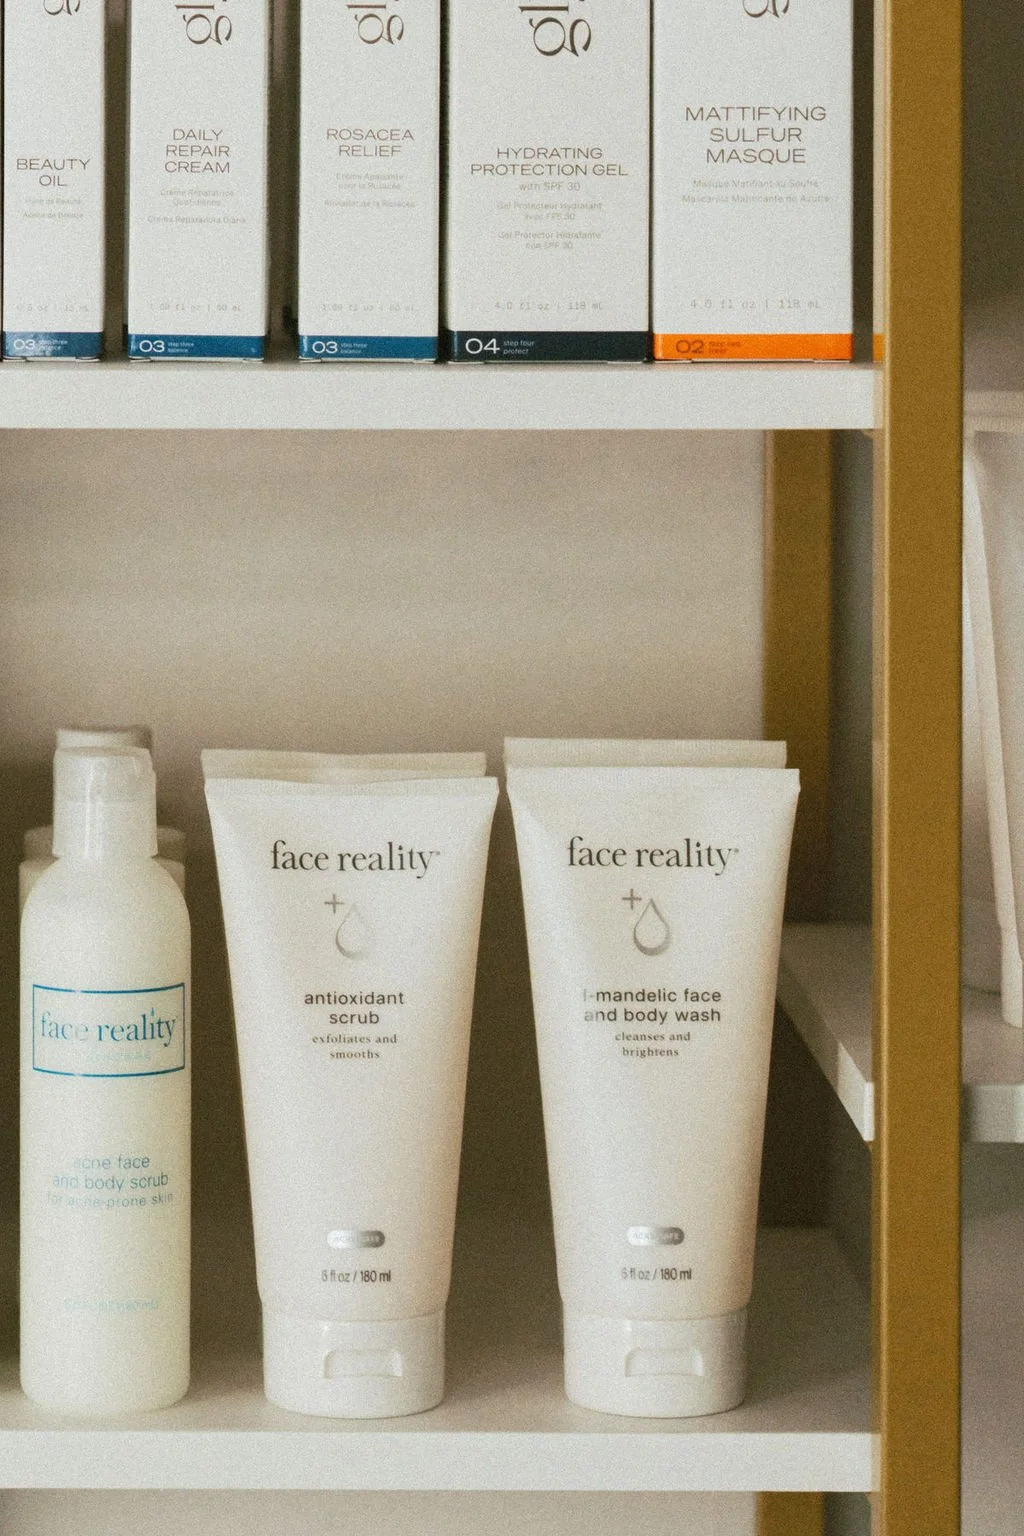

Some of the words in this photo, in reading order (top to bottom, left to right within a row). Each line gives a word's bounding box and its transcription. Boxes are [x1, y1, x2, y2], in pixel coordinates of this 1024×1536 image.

[685, 106, 827, 122] MATTIFYING
[172, 128, 223, 141] DAILY
[326, 128, 415, 141] ROSACEA
[709, 127, 802, 143] SULFUR
[165, 144, 231, 157] REPAIR
[338, 144, 402, 157] RELIEF
[496, 147, 603, 160] HYDRATING
[706, 148, 807, 165] MASQUE
[16, 158, 91, 171] BEAUTY
[164, 161, 231, 174] CREAM
[470, 163, 588, 177] PROTECTION
[592, 163, 629, 177] GEL
[38, 174, 68, 187] OIL
[13, 339, 36, 350] 03
[139, 340, 166, 353] 03
[311, 341, 338, 354] 03
[465, 338, 500, 355] 04
[676, 340, 705, 354] 02
[271, 839, 329, 870] face
[337, 841, 434, 879] reality
[567, 835, 627, 867] face
[635, 838, 733, 876] reality
[304, 991, 405, 1006] antioxidant
[684, 987, 722, 1002] face
[329, 1010, 380, 1025] scrub
[584, 1008, 617, 1022] and
[624, 1008, 668, 1026] body
[675, 1008, 721, 1022] wash
[40, 1011, 89, 1042] face
[97, 1006, 177, 1048] reality
[312, 1033, 371, 1045] exfoliates
[375, 1033, 398, 1044] and
[615, 1032, 665, 1042] cleanses
[669, 1031, 691, 1042] and
[329, 1049, 380, 1060] smooths
[622, 1047, 679, 1059] brightens
[118, 1155, 150, 1169] face
[84, 1174, 124, 1192] body
[129, 1171, 169, 1188] scrub
[360, 1269, 377, 1283] 180
[379, 1269, 392, 1282] ml
[661, 1267, 677, 1281] 180
[679, 1267, 692, 1280] ml
